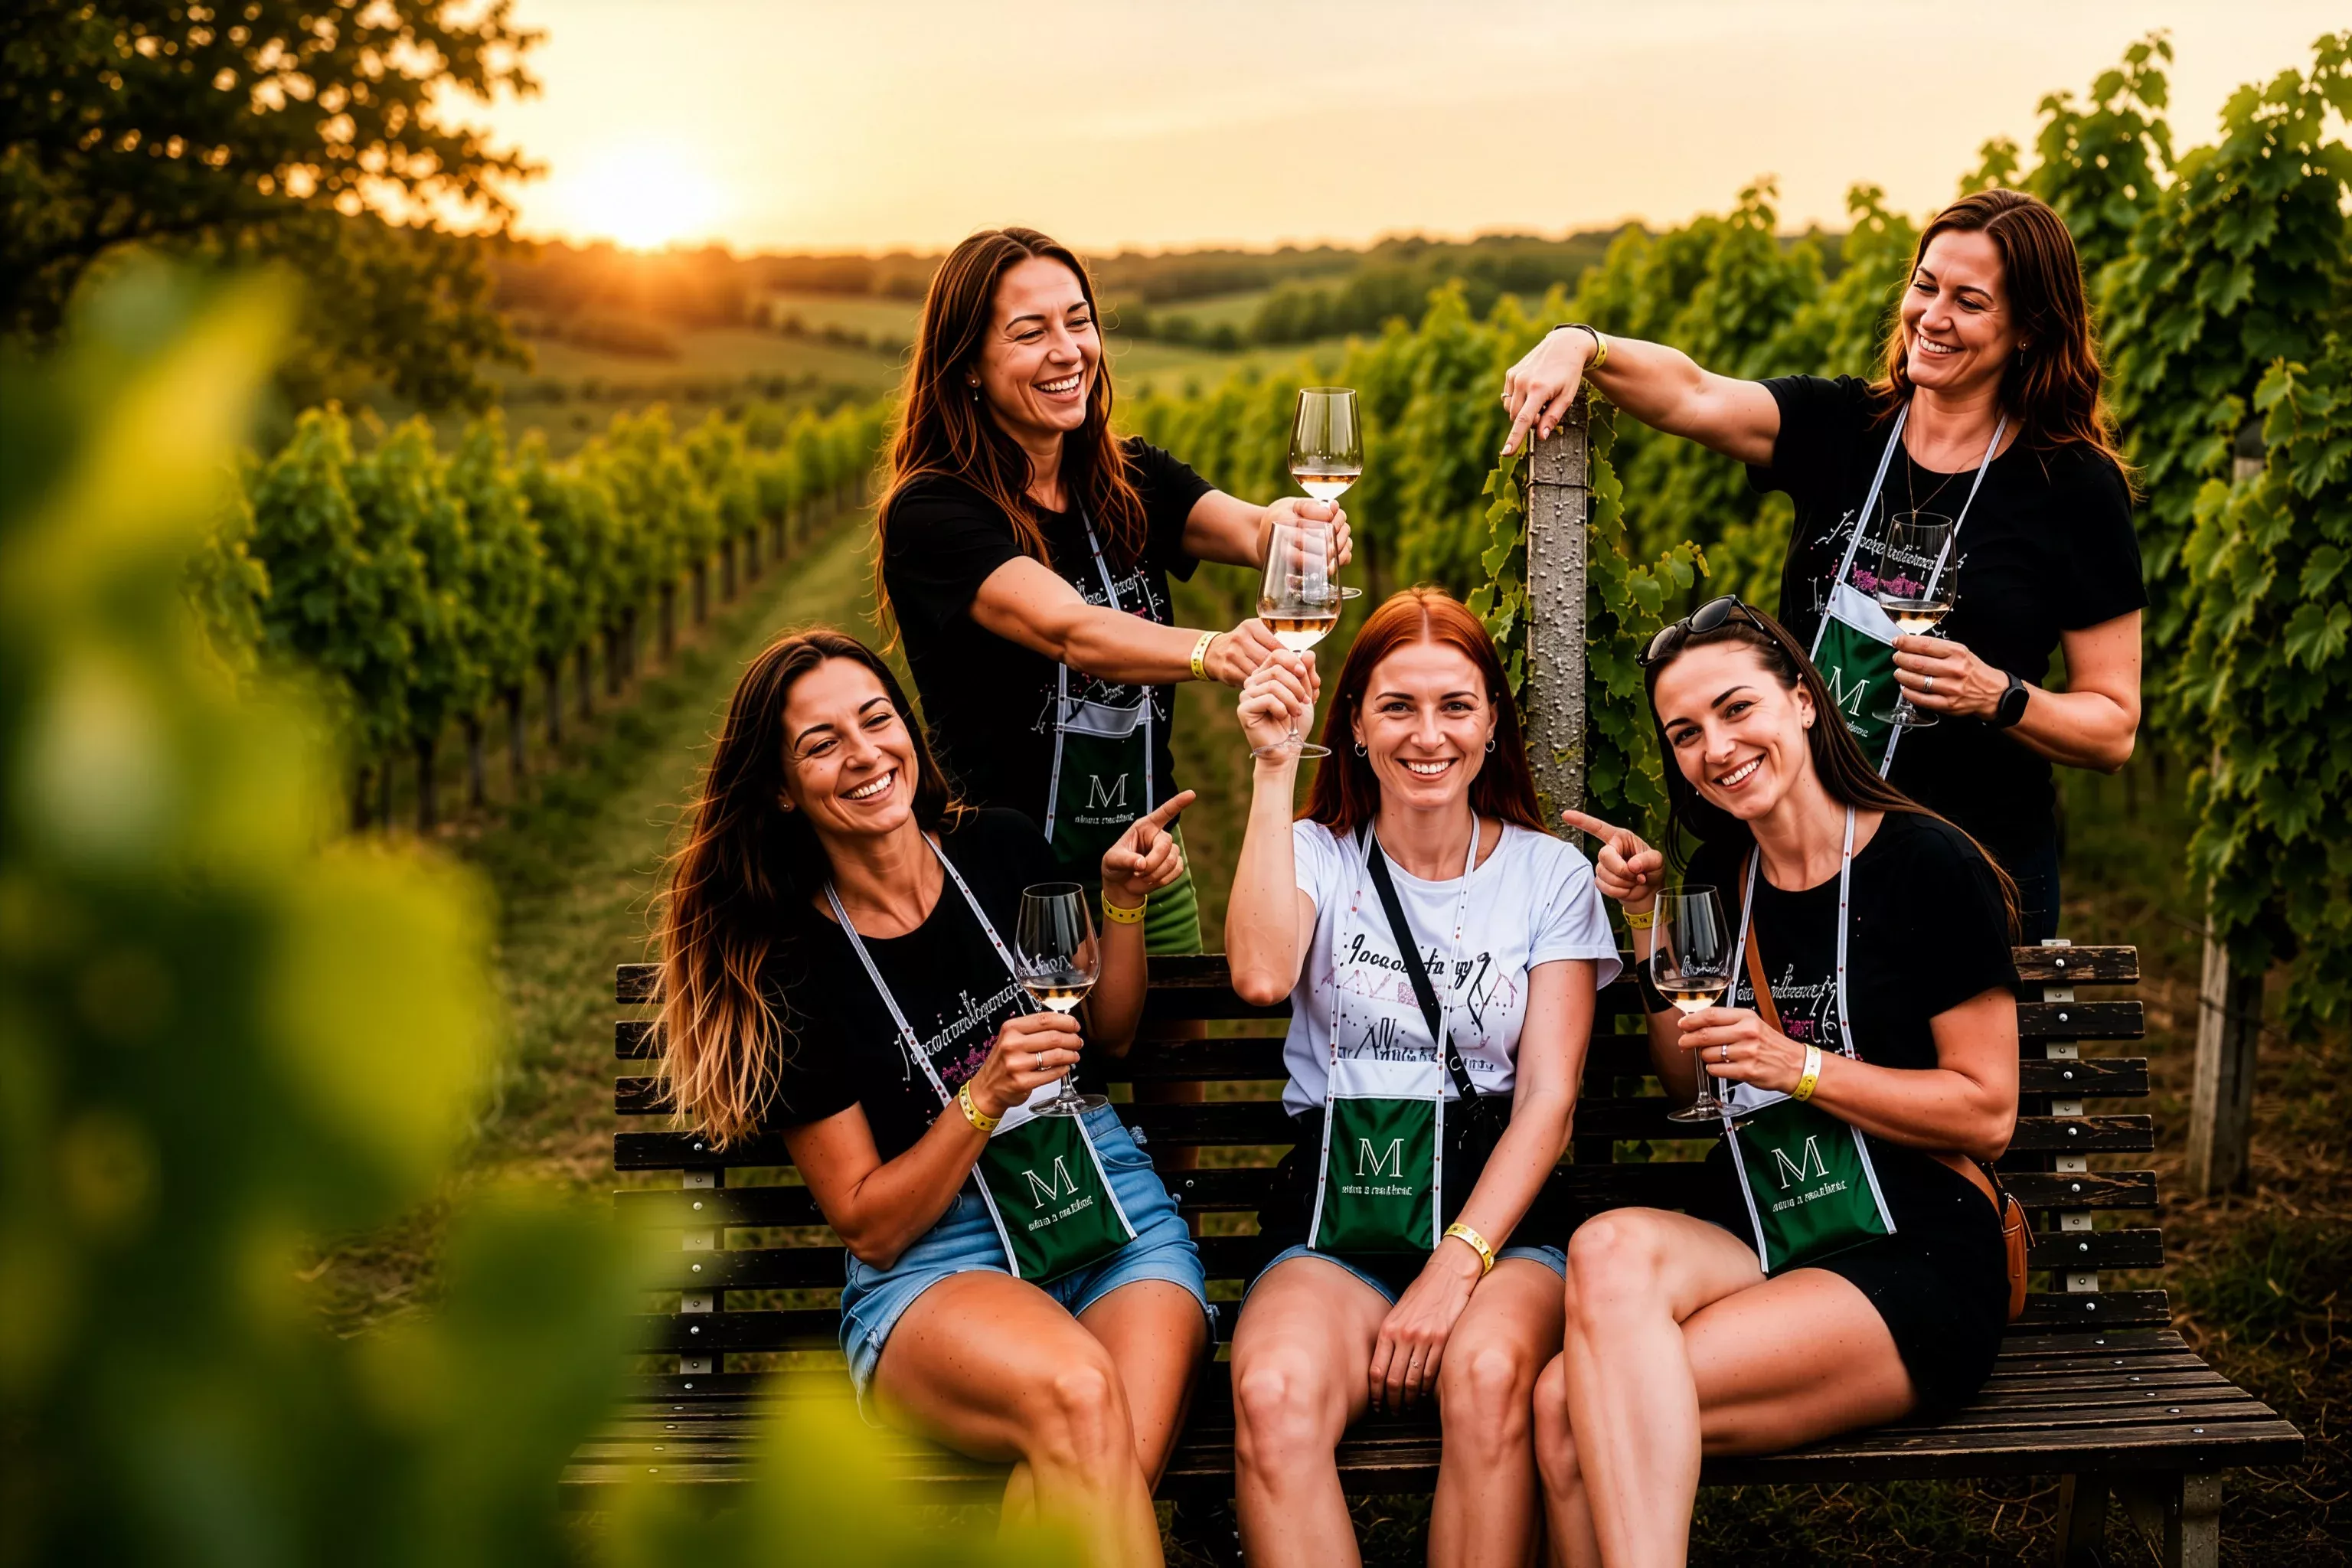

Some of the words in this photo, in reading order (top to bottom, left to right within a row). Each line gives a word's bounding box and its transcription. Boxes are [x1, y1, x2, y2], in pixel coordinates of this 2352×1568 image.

[1828, 665, 1870, 717] M
[1086, 773, 1129, 808] M
[1021, 1155, 1079, 1209] M
[1355, 1138, 1404, 1178] M
[1770, 1135, 1830, 1190] M
